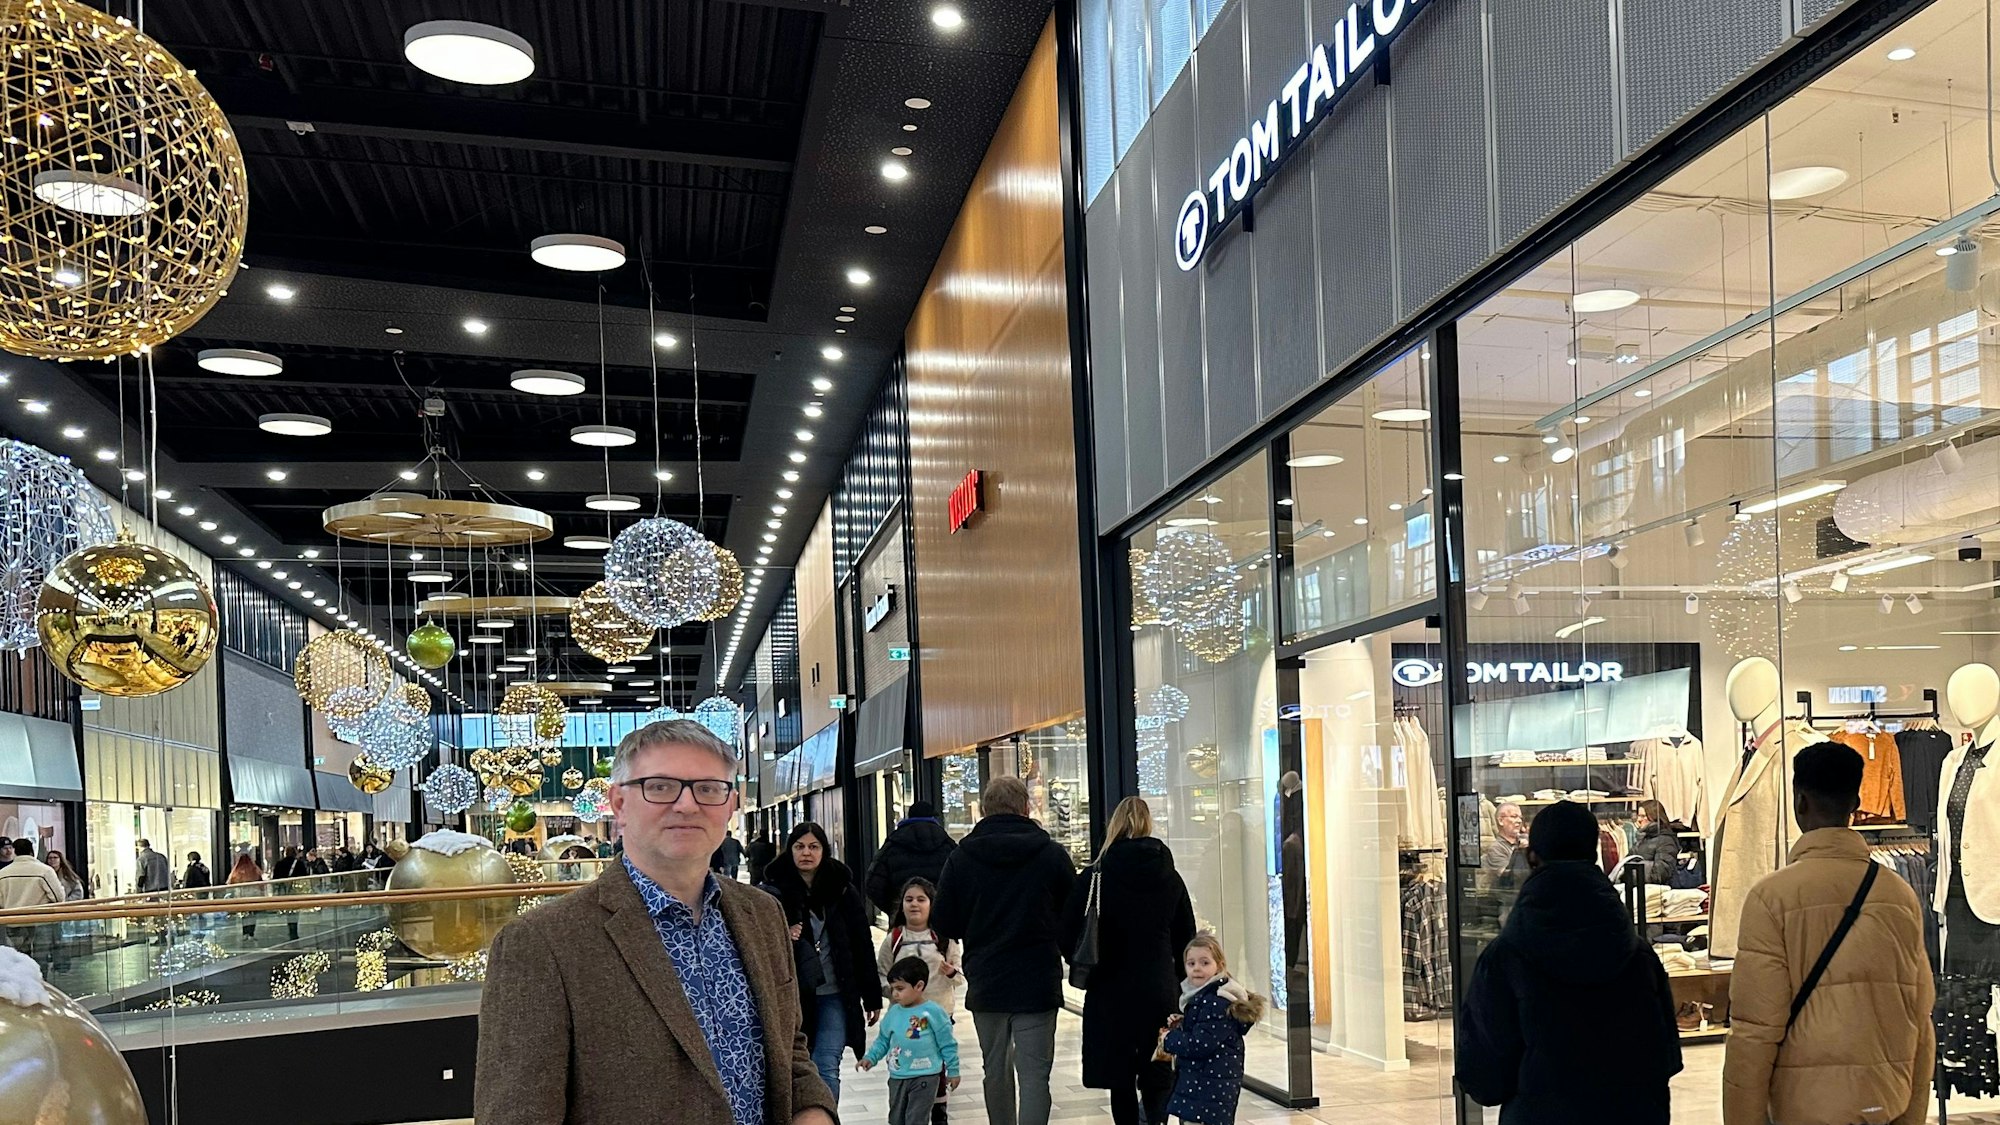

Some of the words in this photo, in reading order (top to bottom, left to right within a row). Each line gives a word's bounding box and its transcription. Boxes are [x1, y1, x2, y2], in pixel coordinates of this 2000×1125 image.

[1209, 100, 1280, 223] TOM
[1282, 0, 1417, 138] TAILO
[1438, 662, 1508, 683] OM
[1510, 662, 1623, 683] TAILOR
[1460, 834, 1478, 846] SALE
